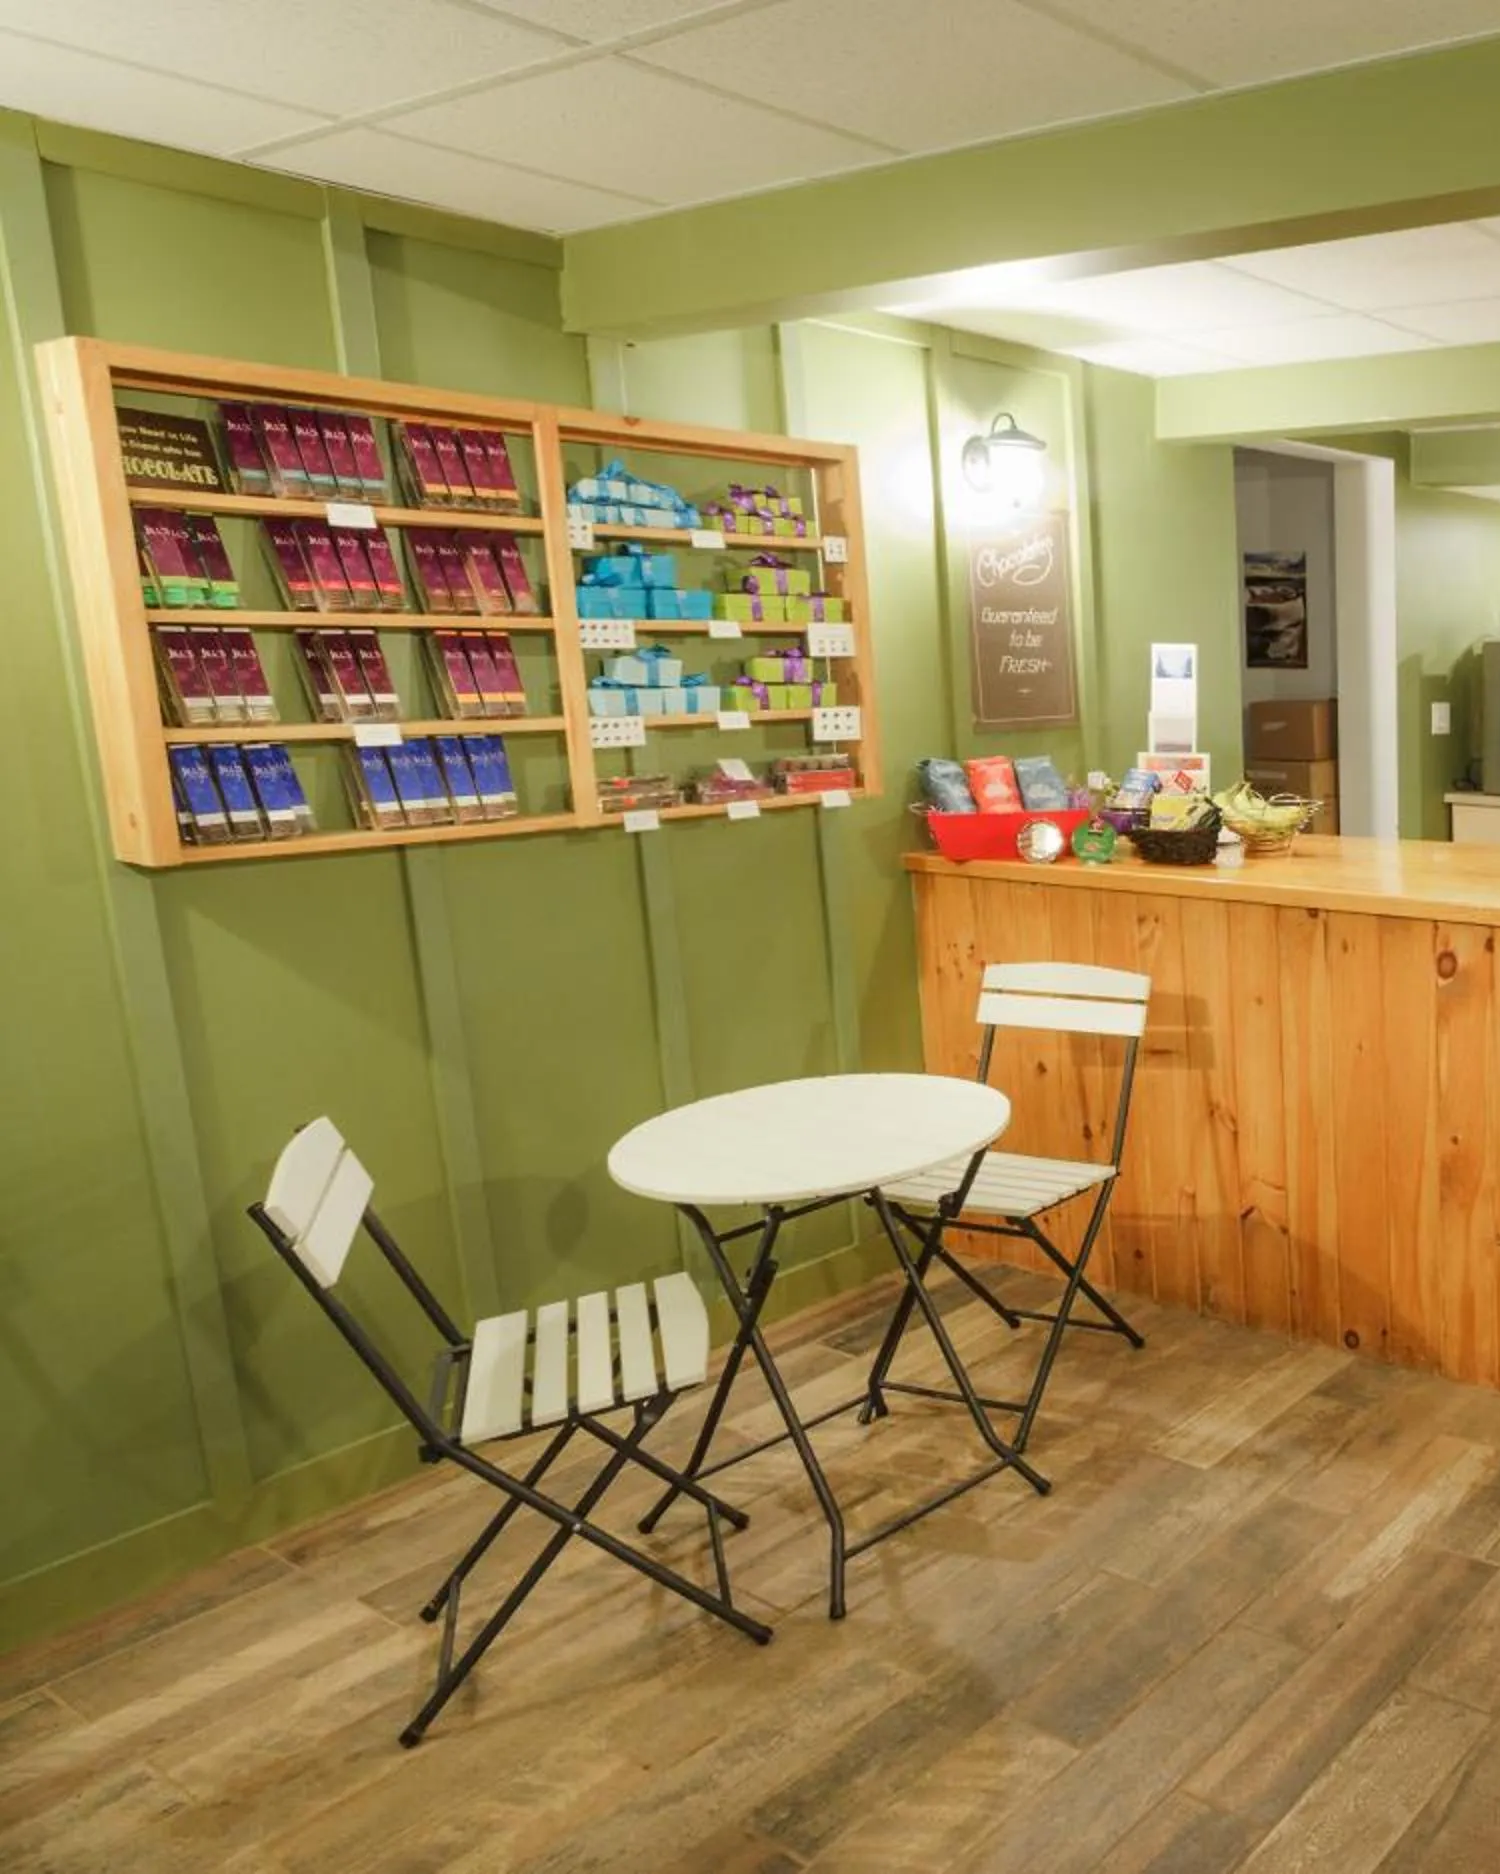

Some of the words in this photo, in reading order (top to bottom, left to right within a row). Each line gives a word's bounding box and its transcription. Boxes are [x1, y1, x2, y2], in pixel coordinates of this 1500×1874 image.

[120, 456, 219, 486] HOCOLATE
[981, 606, 1058, 625] Guaranteed
[1009, 630, 1024, 647] to
[1026, 630, 1043, 647] be
[1000, 655, 1052, 673] FRESH
